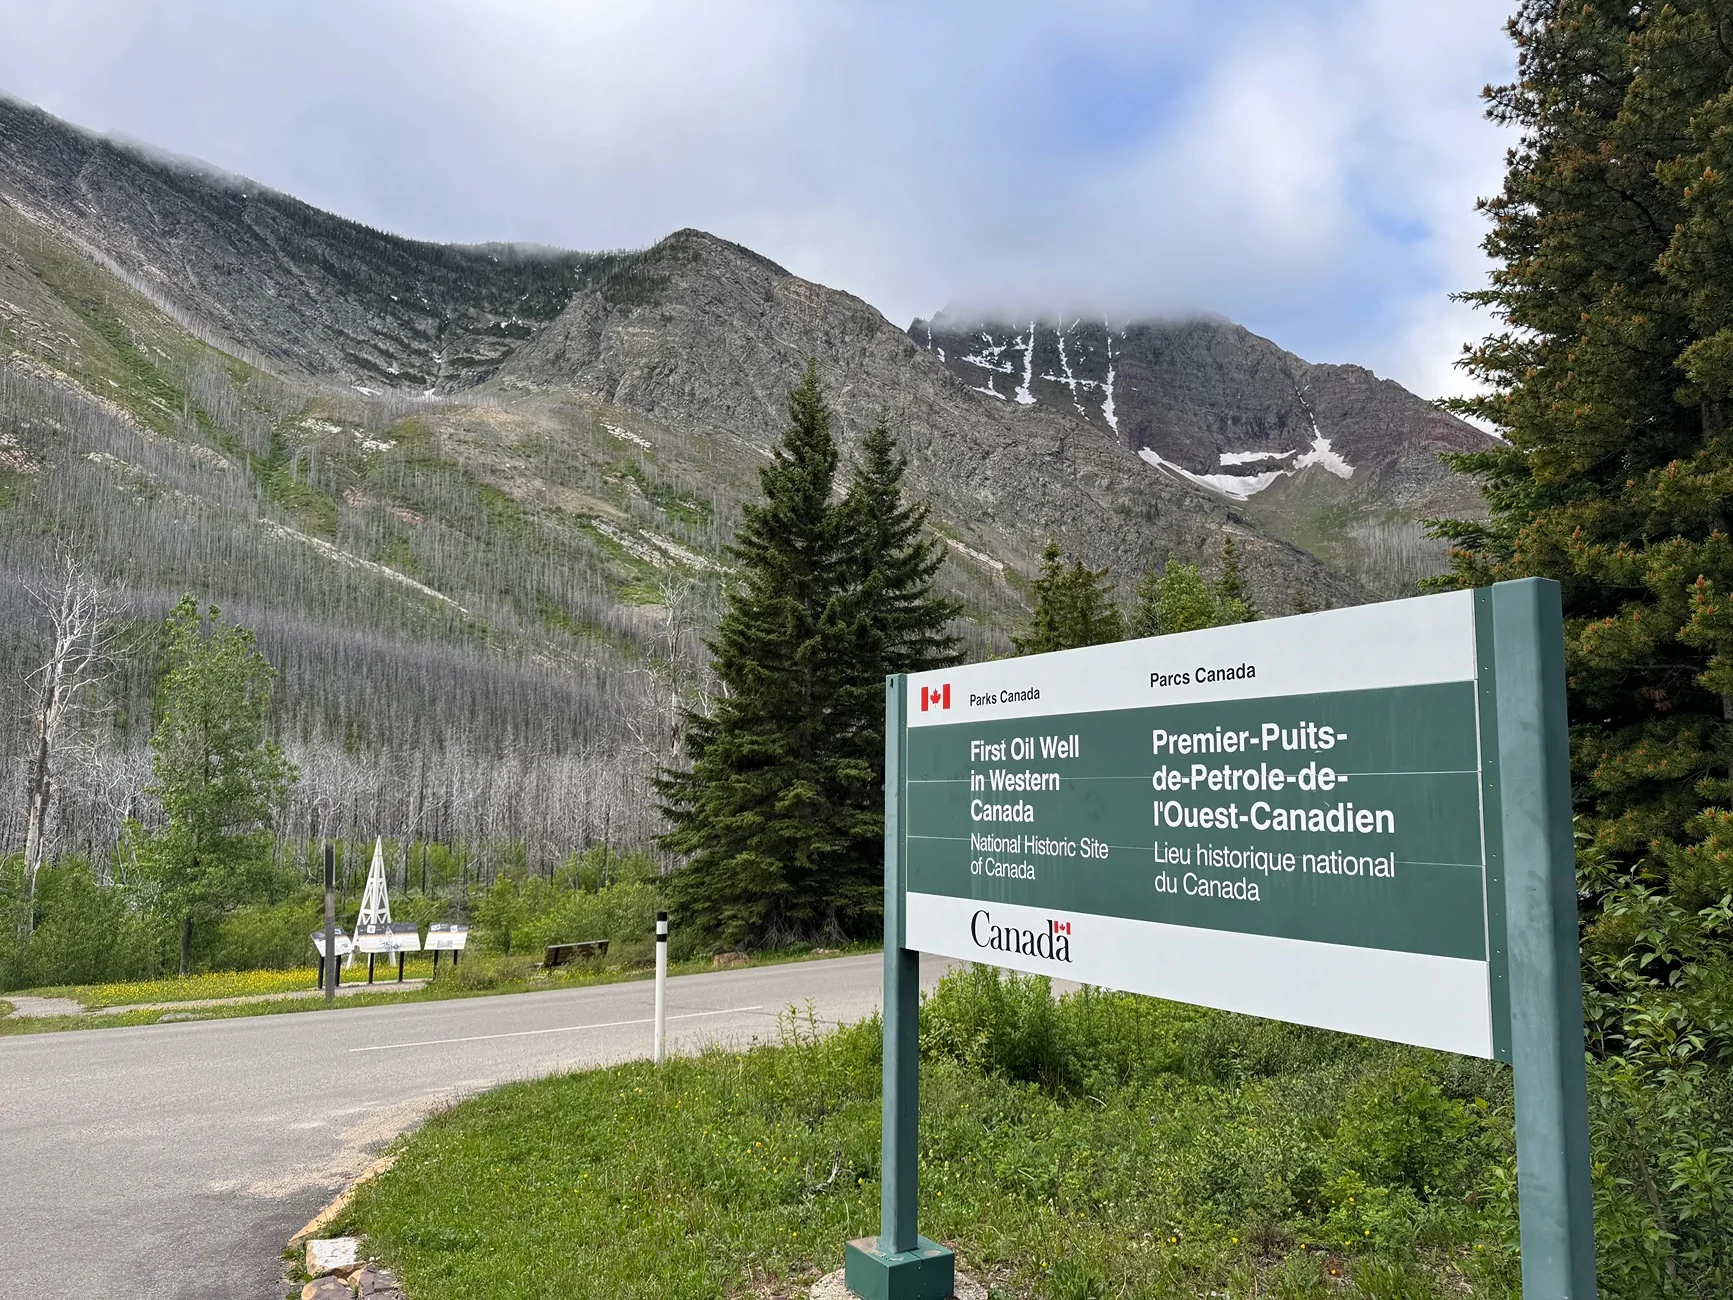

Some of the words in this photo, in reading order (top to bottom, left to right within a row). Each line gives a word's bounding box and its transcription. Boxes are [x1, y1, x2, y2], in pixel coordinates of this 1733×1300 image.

[1150, 673, 1191, 687] Parcs
[1195, 663, 1256, 683] Canada
[969, 693, 998, 706] Parks
[999, 687, 1040, 703] Canada
[971, 739, 1007, 761] First
[1011, 737, 1035, 760] Oil
[1039, 735, 1080, 758] Well
[1153, 721, 1348, 754] Premier-Puits-
[970, 770, 986, 791] in
[989, 769, 1060, 791] Western
[1152, 762, 1349, 791] de-Petrole-de-
[971, 799, 1035, 822] Canada
[1154, 801, 1395, 833] l'Ouest-Canadien
[971, 833, 1021, 853] National
[1025, 835, 1077, 856] Historic
[1080, 837, 1109, 859] Site
[1155, 841, 1191, 864] Lieu
[1197, 844, 1296, 876] historique
[1303, 850, 1395, 877] national
[971, 857, 983, 874] of
[985, 857, 1036, 879] Canada
[1155, 871, 1178, 893] du
[1183, 873, 1261, 901] Canada
[971, 910, 1073, 962] Canada
